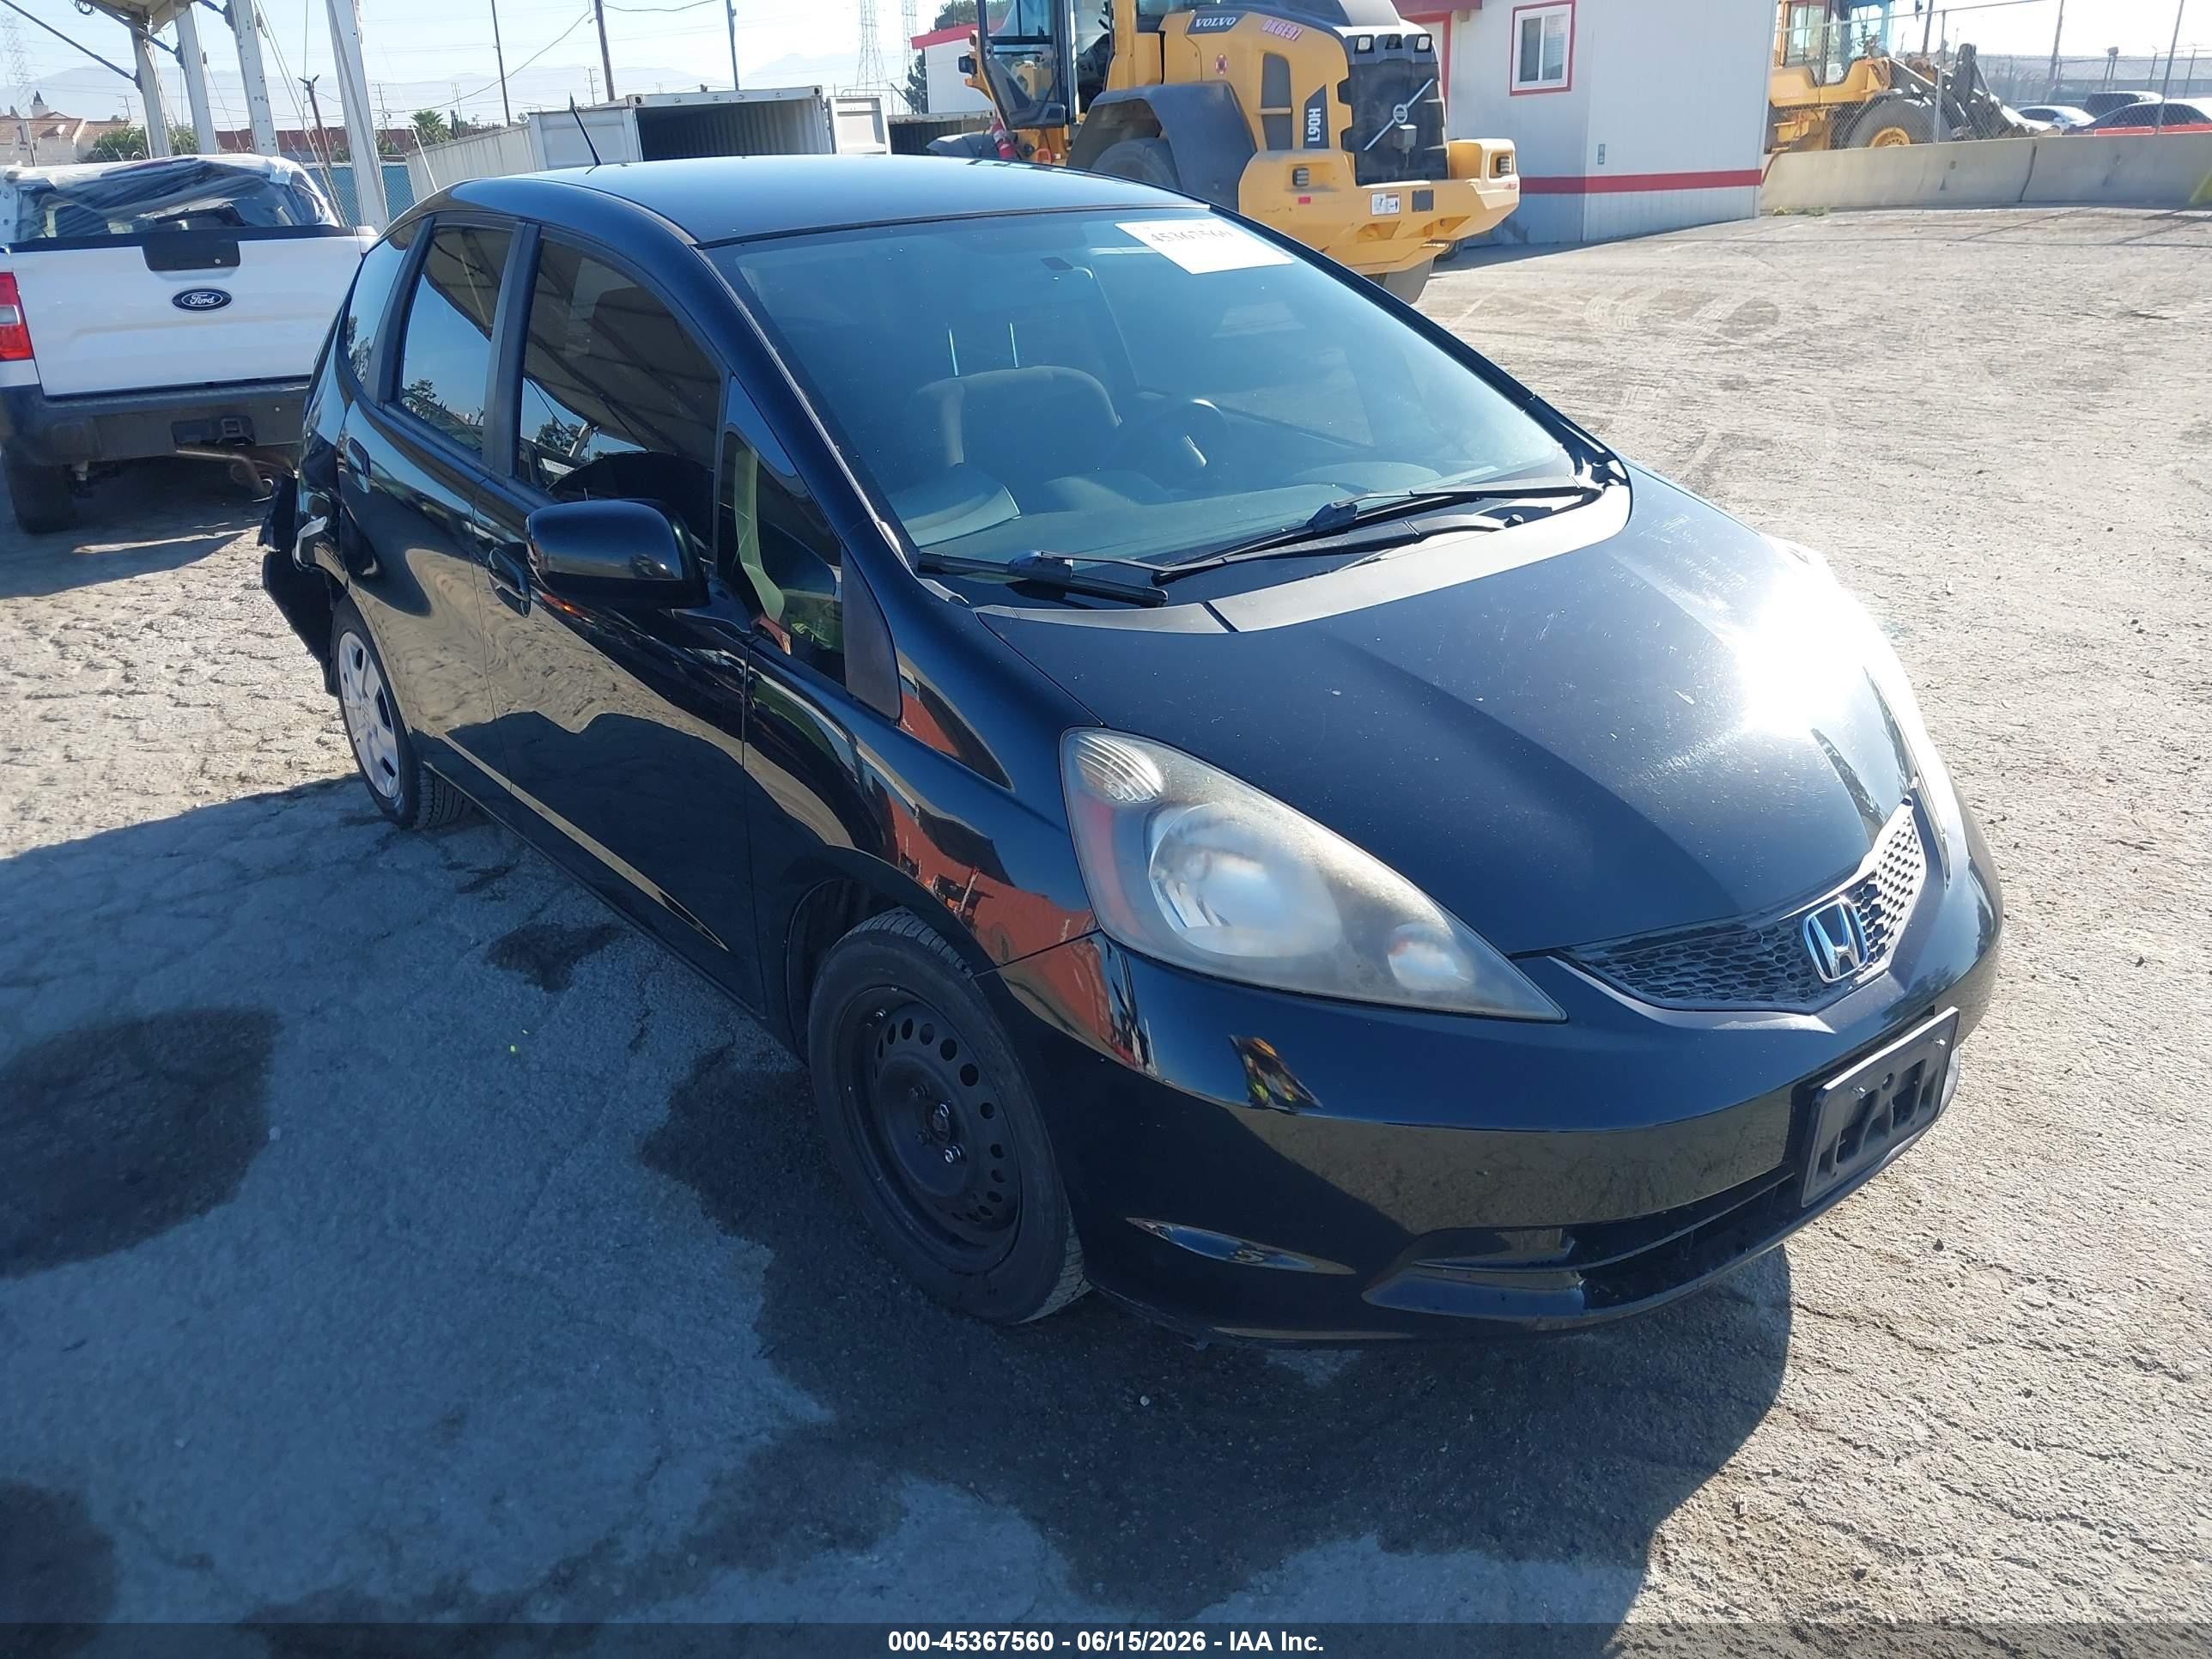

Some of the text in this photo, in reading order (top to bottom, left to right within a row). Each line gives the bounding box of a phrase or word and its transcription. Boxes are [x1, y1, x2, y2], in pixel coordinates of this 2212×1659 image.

[1195, 16, 1237, 27] VOLVO
[1308, 107, 1322, 143] L90H
[190, 294, 216, 305] Ford
